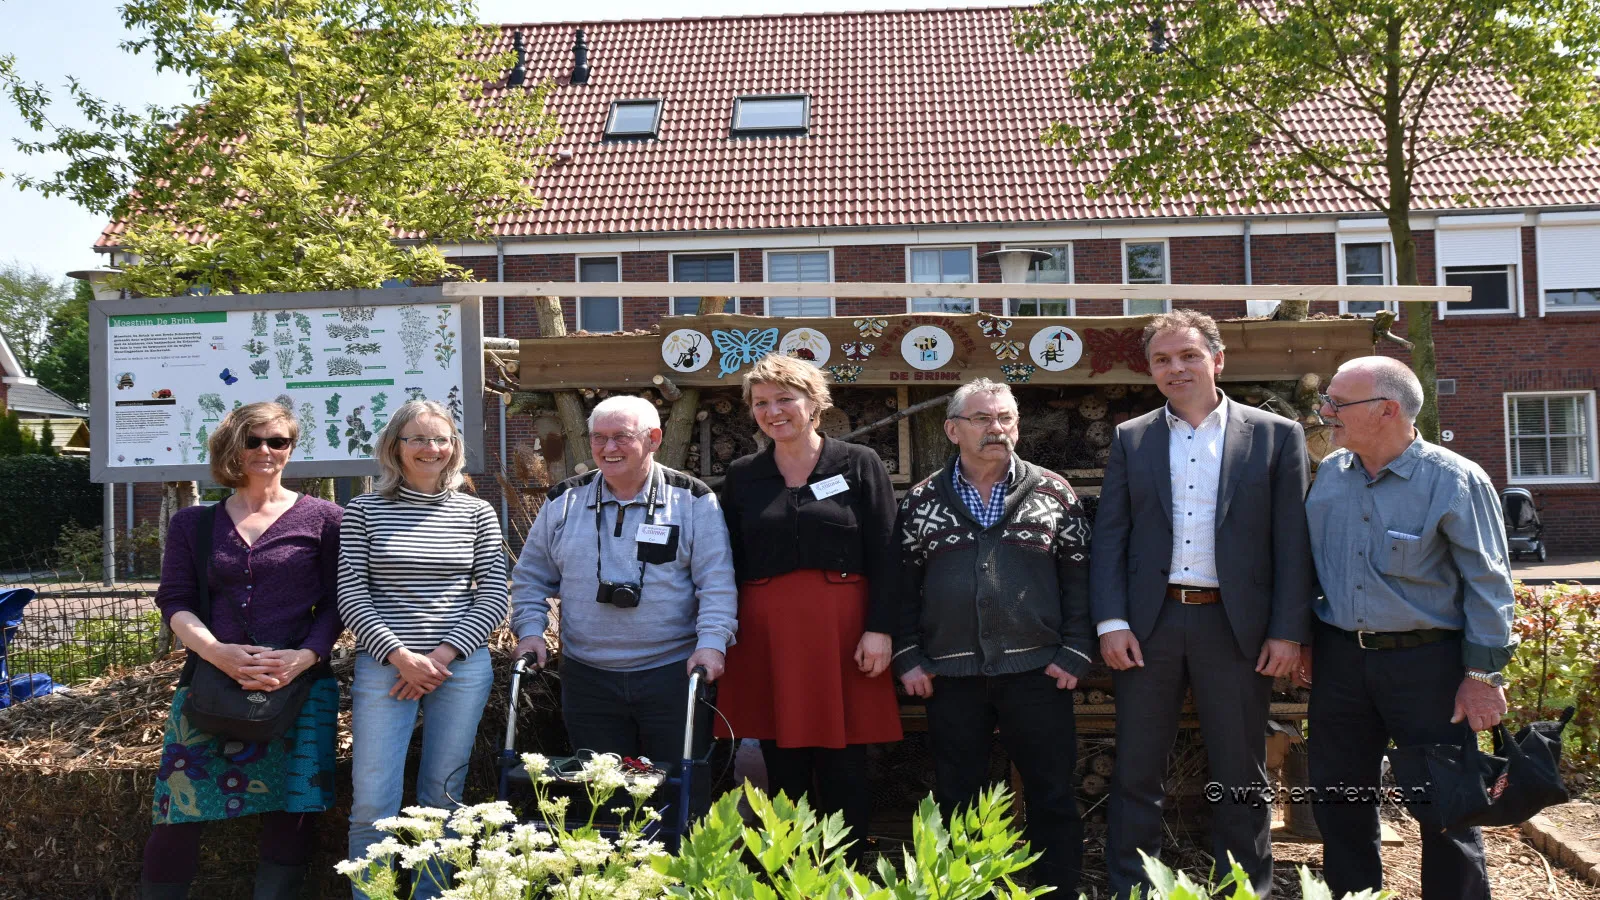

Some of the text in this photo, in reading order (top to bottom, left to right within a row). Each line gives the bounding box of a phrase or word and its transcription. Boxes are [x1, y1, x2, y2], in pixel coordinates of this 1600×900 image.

[112, 318, 154, 327] Moestuin
[171, 317, 196, 325] Brink
[889, 371, 961, 381] DE BRINK
[1441, 429, 1454, 442] 9
